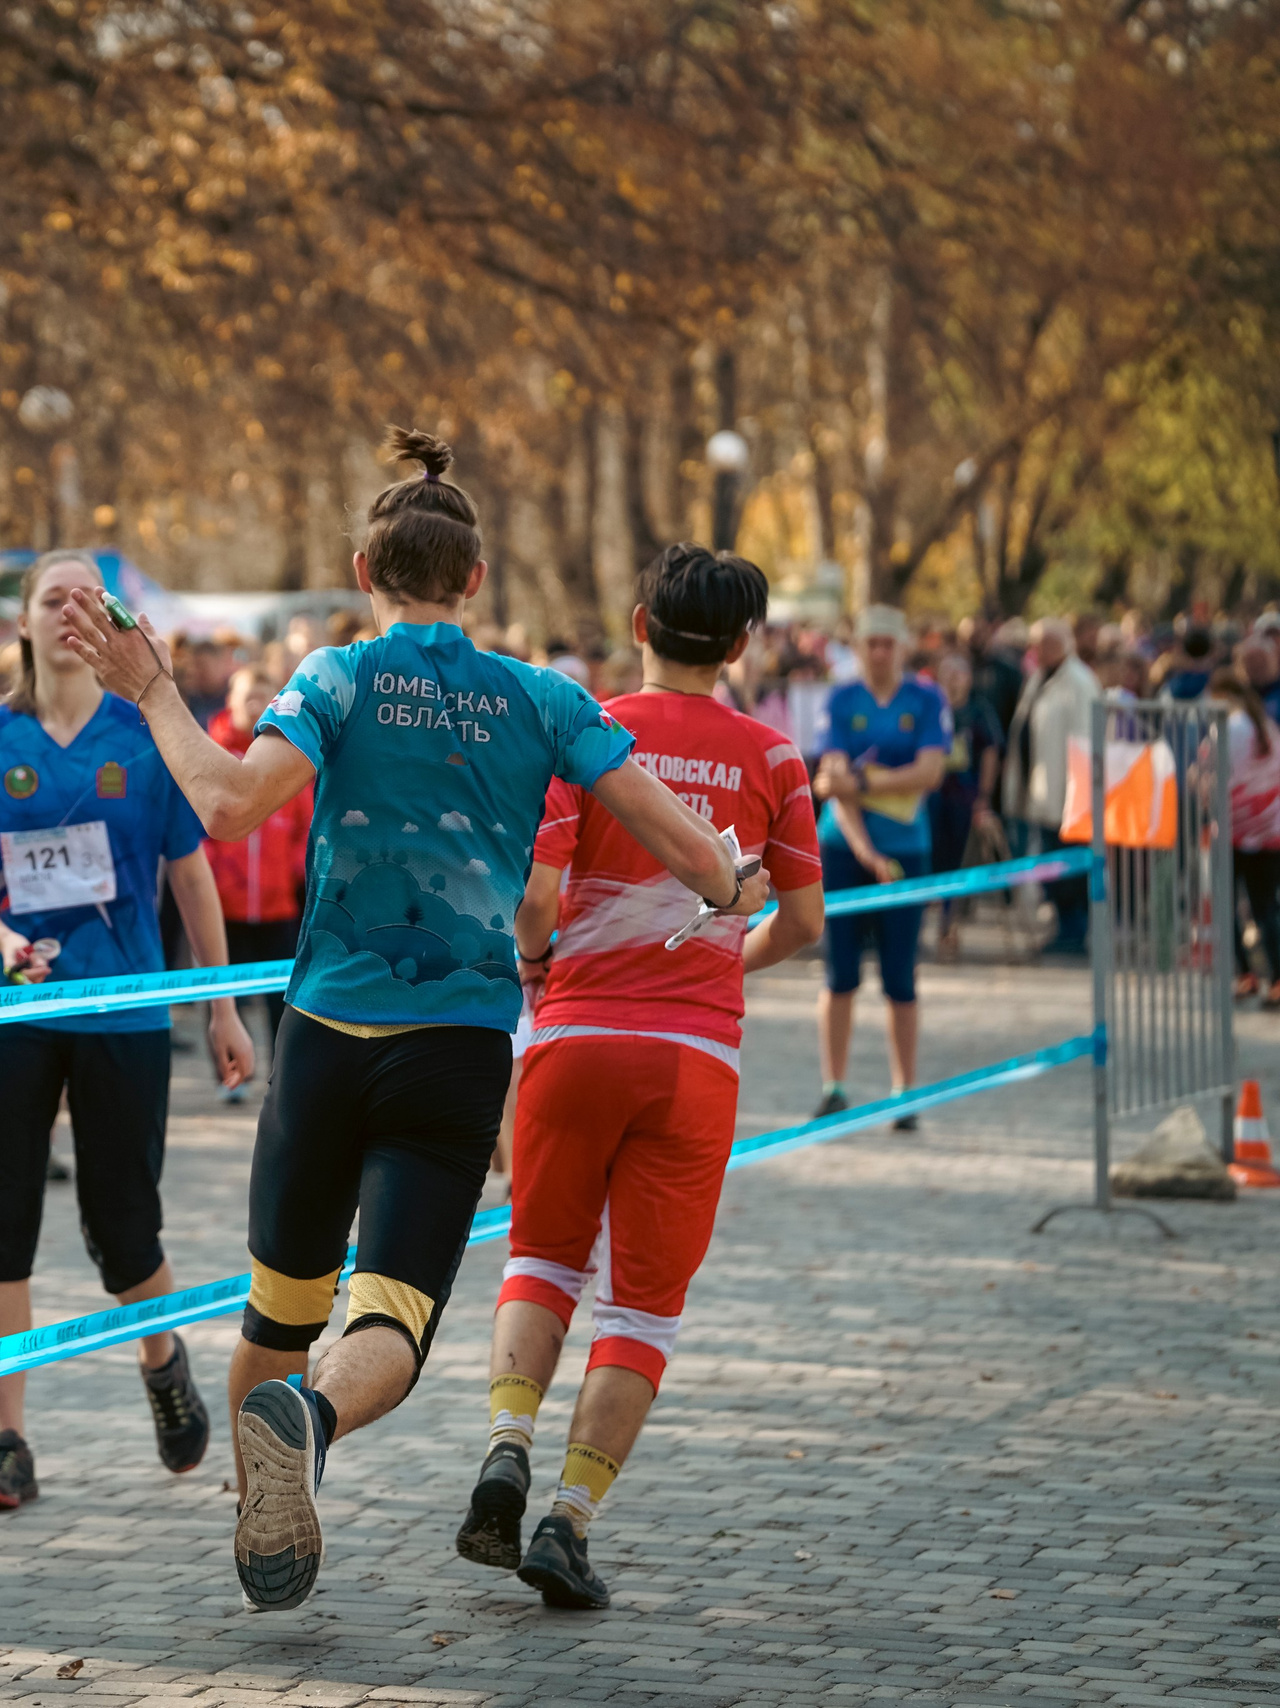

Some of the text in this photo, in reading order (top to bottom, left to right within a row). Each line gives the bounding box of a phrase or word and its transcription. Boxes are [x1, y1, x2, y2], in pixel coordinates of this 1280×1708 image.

[373, 672, 510, 716] ЮМЕСКАЯ
[377, 703, 491, 743] ОБЛАТЬ
[25, 845, 70, 870] 121
